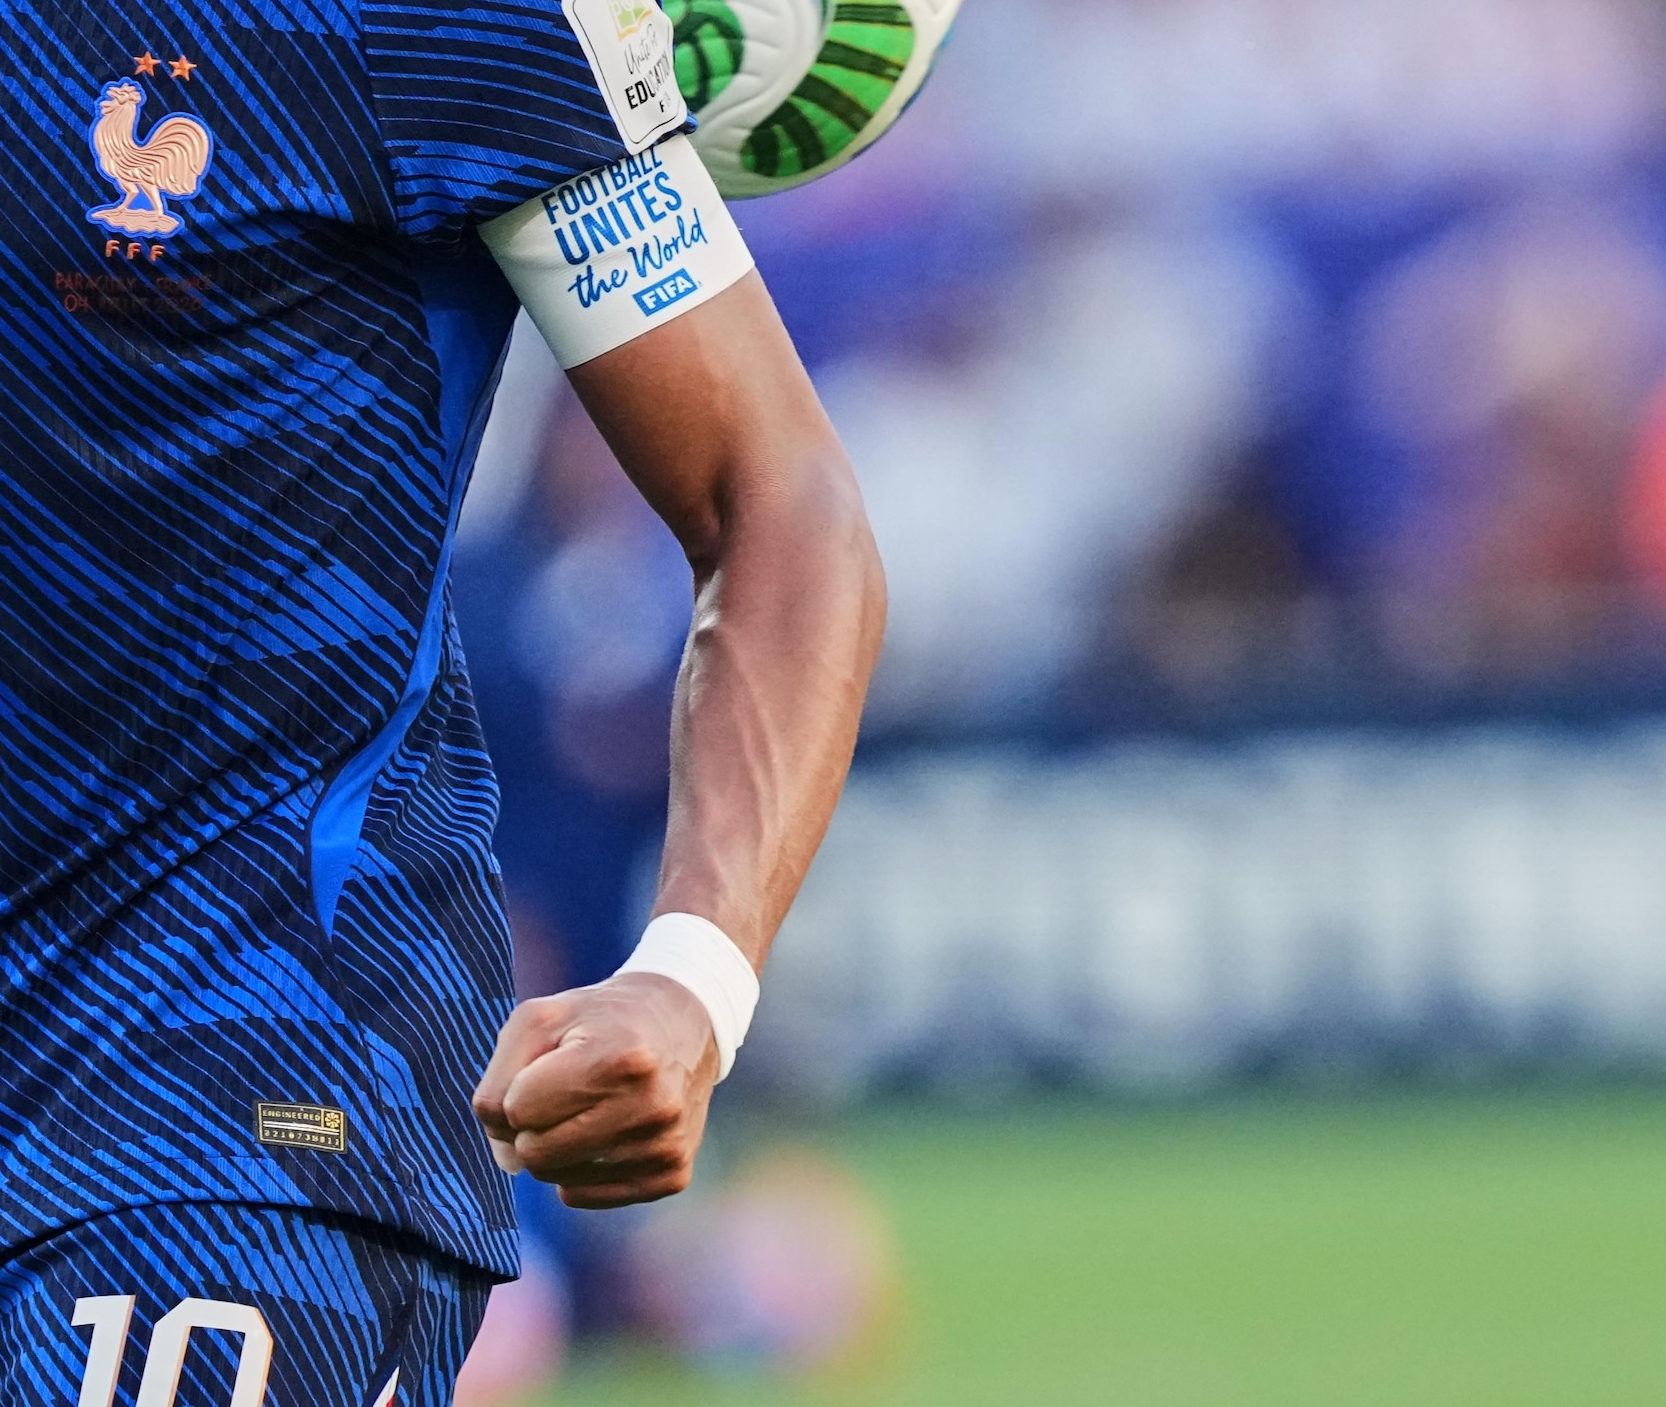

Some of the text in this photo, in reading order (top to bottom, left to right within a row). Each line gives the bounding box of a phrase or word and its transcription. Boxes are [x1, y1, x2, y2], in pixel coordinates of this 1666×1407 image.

[543, 146, 663, 225] FOOTBALL
[554, 171, 683, 266] UNITES
[567, 208, 709, 309] the World
[640, 273, 698, 312] FIFA
[262, 1109, 321, 1121] ENGINEERED
[70, 1293, 275, 1407] 10
